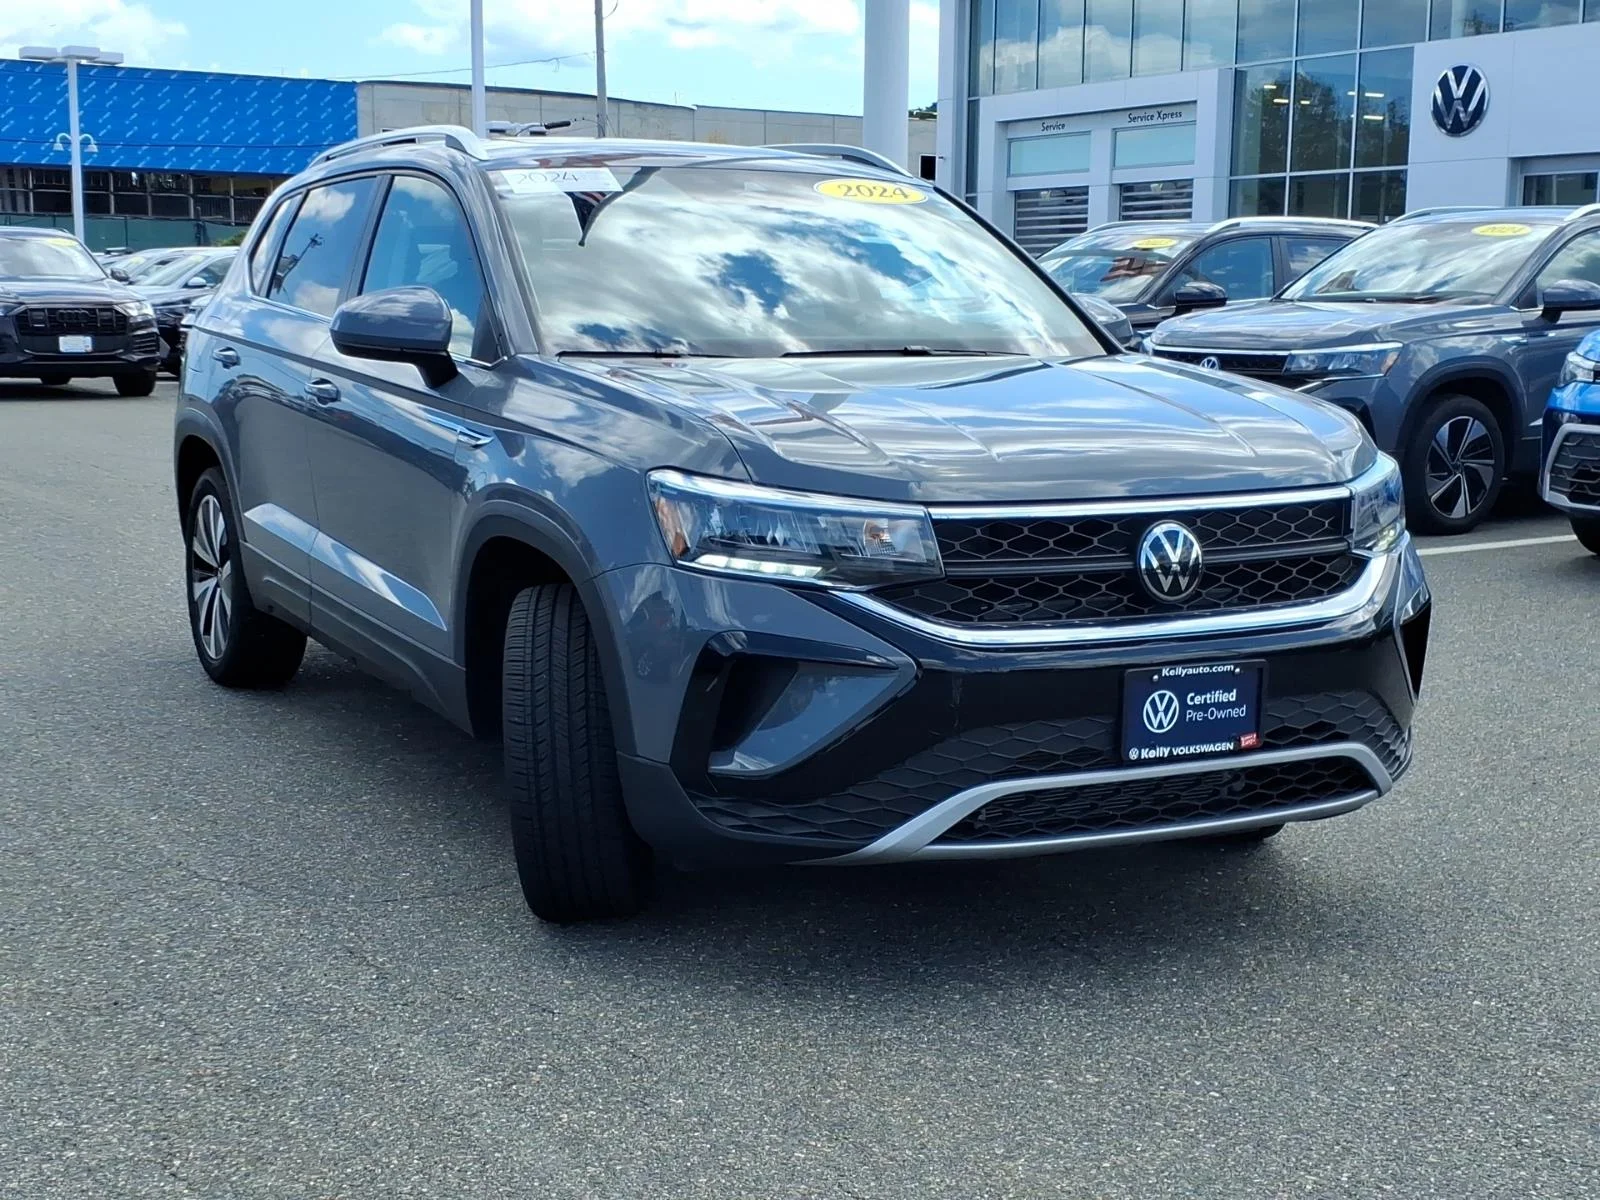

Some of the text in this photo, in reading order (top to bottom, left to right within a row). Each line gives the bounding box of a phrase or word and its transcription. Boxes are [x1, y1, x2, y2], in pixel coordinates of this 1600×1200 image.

[1431, 63, 1490, 137] VW
[1127, 110, 1182, 124] Service Xpress
[1041, 121, 1066, 132] Service
[517, 171, 578, 184] 2024
[837, 183, 910, 199] 2024
[1138, 520, 1203, 602] VW
[1161, 664, 1234, 677] Kellyauto.com
[1186, 689, 1237, 705] Certified
[1143, 690, 1179, 733] VW
[1186, 705, 1247, 722] Pre-Owned
[1140, 746, 1171, 759] Kelly
[1172, 742, 1234, 755] VOLKSWAGEN
